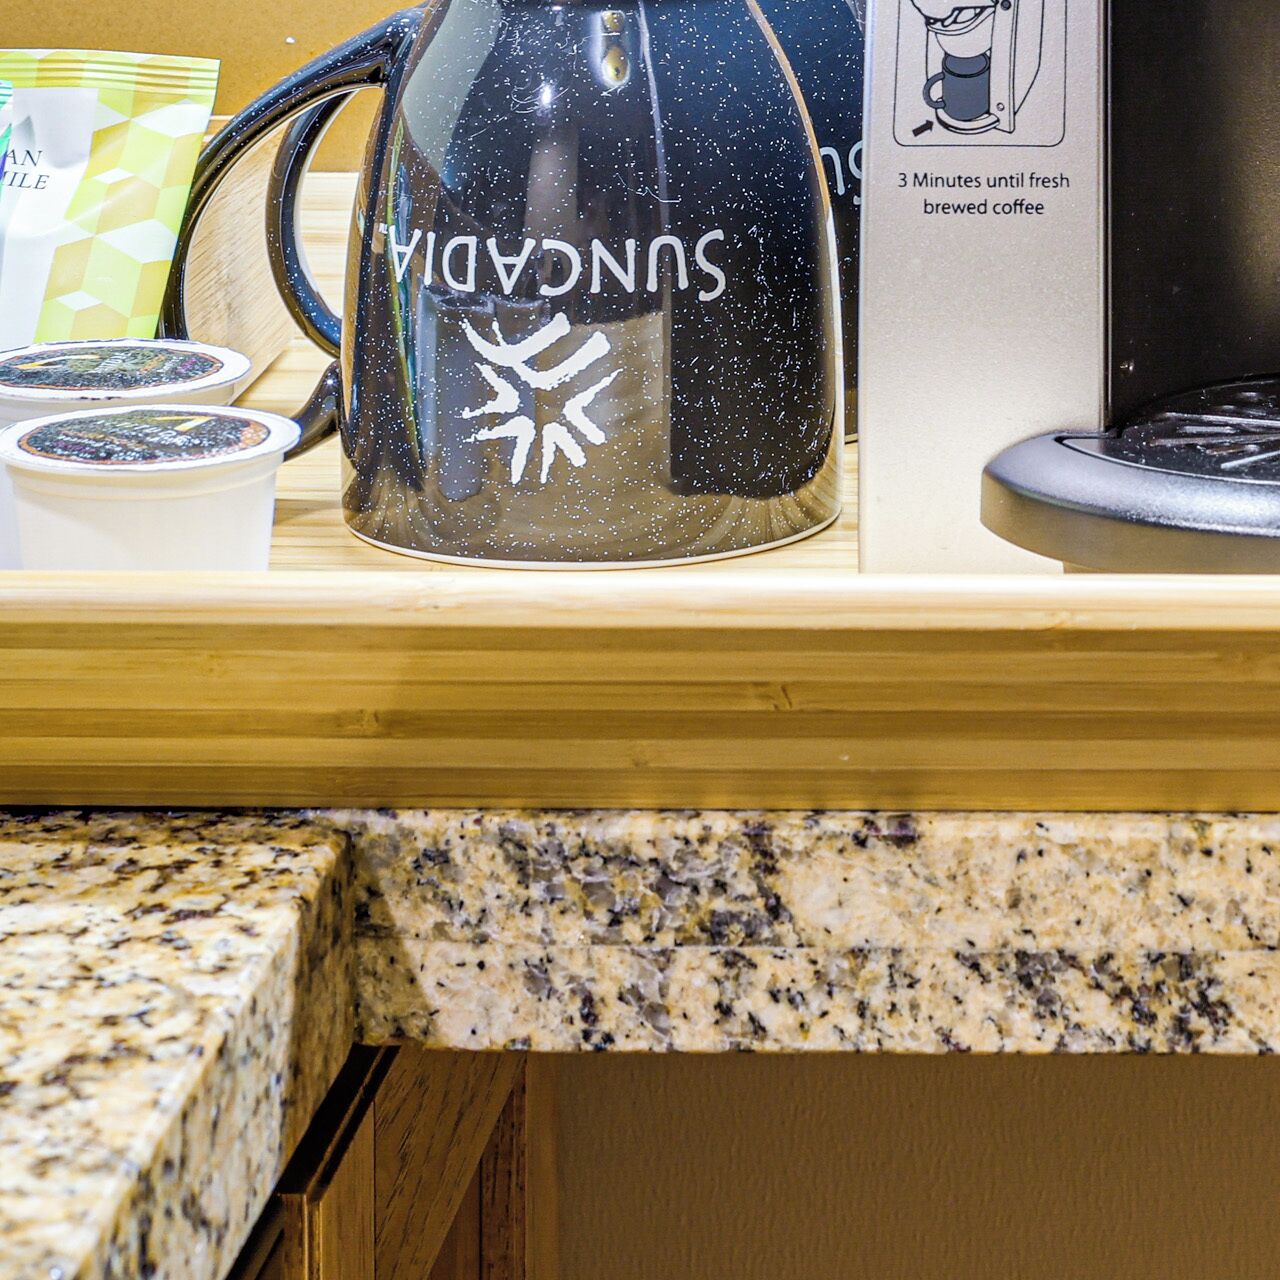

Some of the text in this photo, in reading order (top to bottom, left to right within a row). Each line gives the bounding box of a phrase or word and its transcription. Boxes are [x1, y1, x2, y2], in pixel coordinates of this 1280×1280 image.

[897, 173, 1070, 188] 3 Minutes until fresh
[923, 199, 1045, 215] brewed coffee
[389, 224, 726, 302] SUNCADIA
